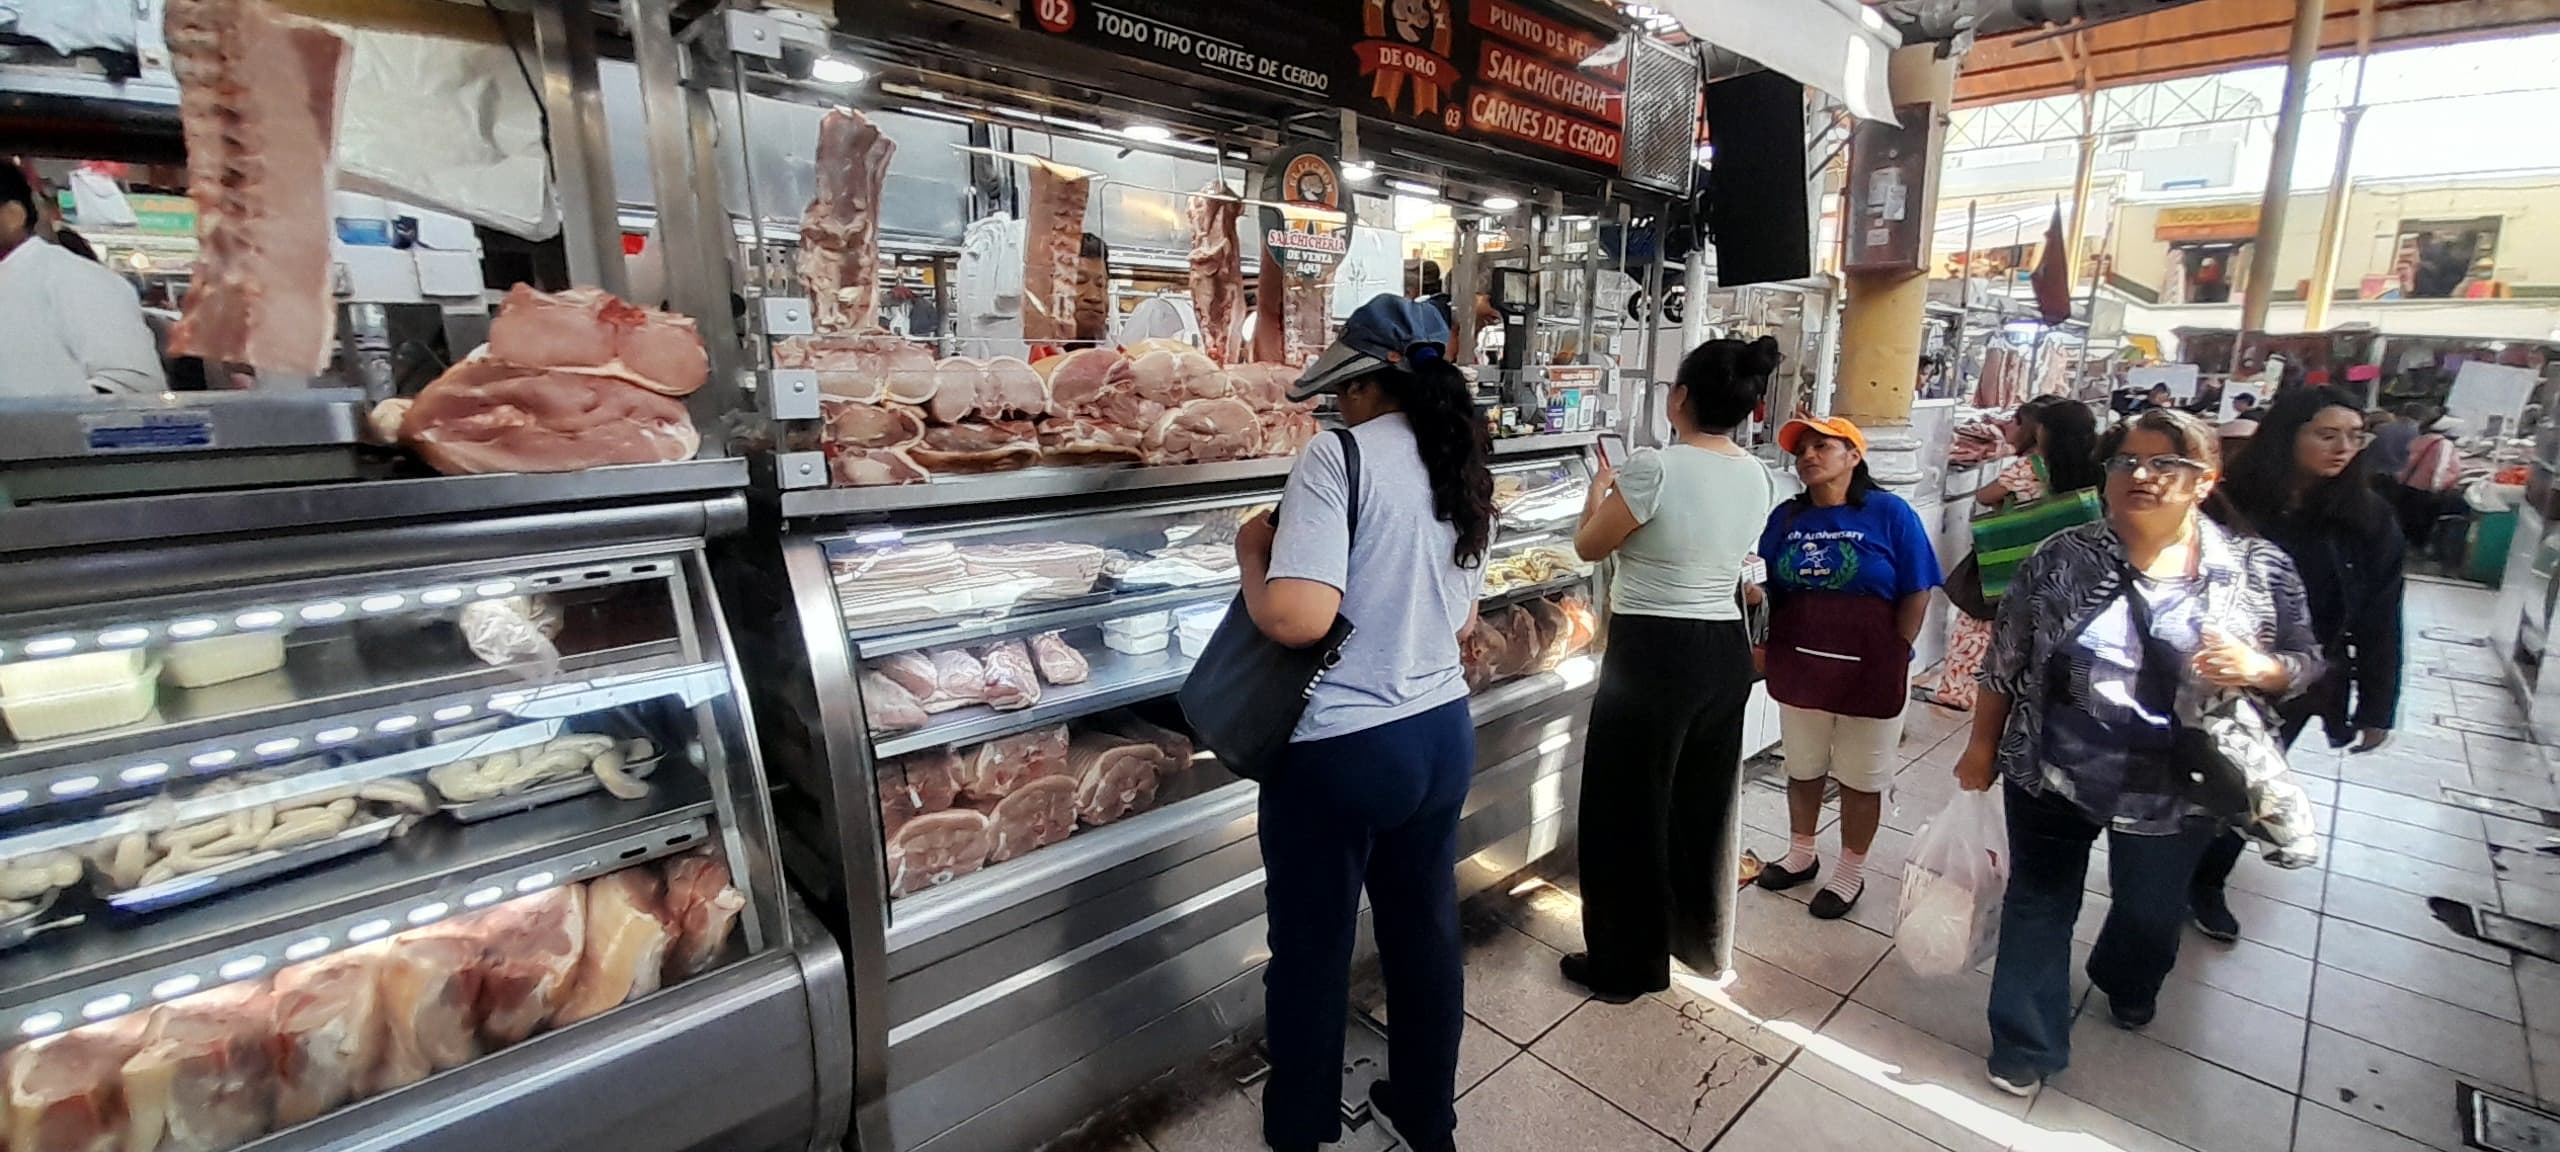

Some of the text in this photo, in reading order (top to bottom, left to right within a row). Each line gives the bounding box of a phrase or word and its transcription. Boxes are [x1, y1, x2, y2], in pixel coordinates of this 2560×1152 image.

[1041, 0, 1068, 24] 02
[1490, 5, 1542, 43] PUNTO
[1545, 28, 1565, 53] DE
[1096, 11, 1148, 42] TODO
[1153, 27, 1191, 55] TIPO
[1195, 41, 1255, 71] CORTES
[1257, 57, 1279, 78] DE
[1281, 64, 1329, 91] CERDO
[1380, 47, 1436, 76] DE ORO
[1445, 109, 1460, 127] 03
[1471, 93, 1616, 158] CARNES DE CERDO
[1287, 249, 1333, 263] DE VENTA
